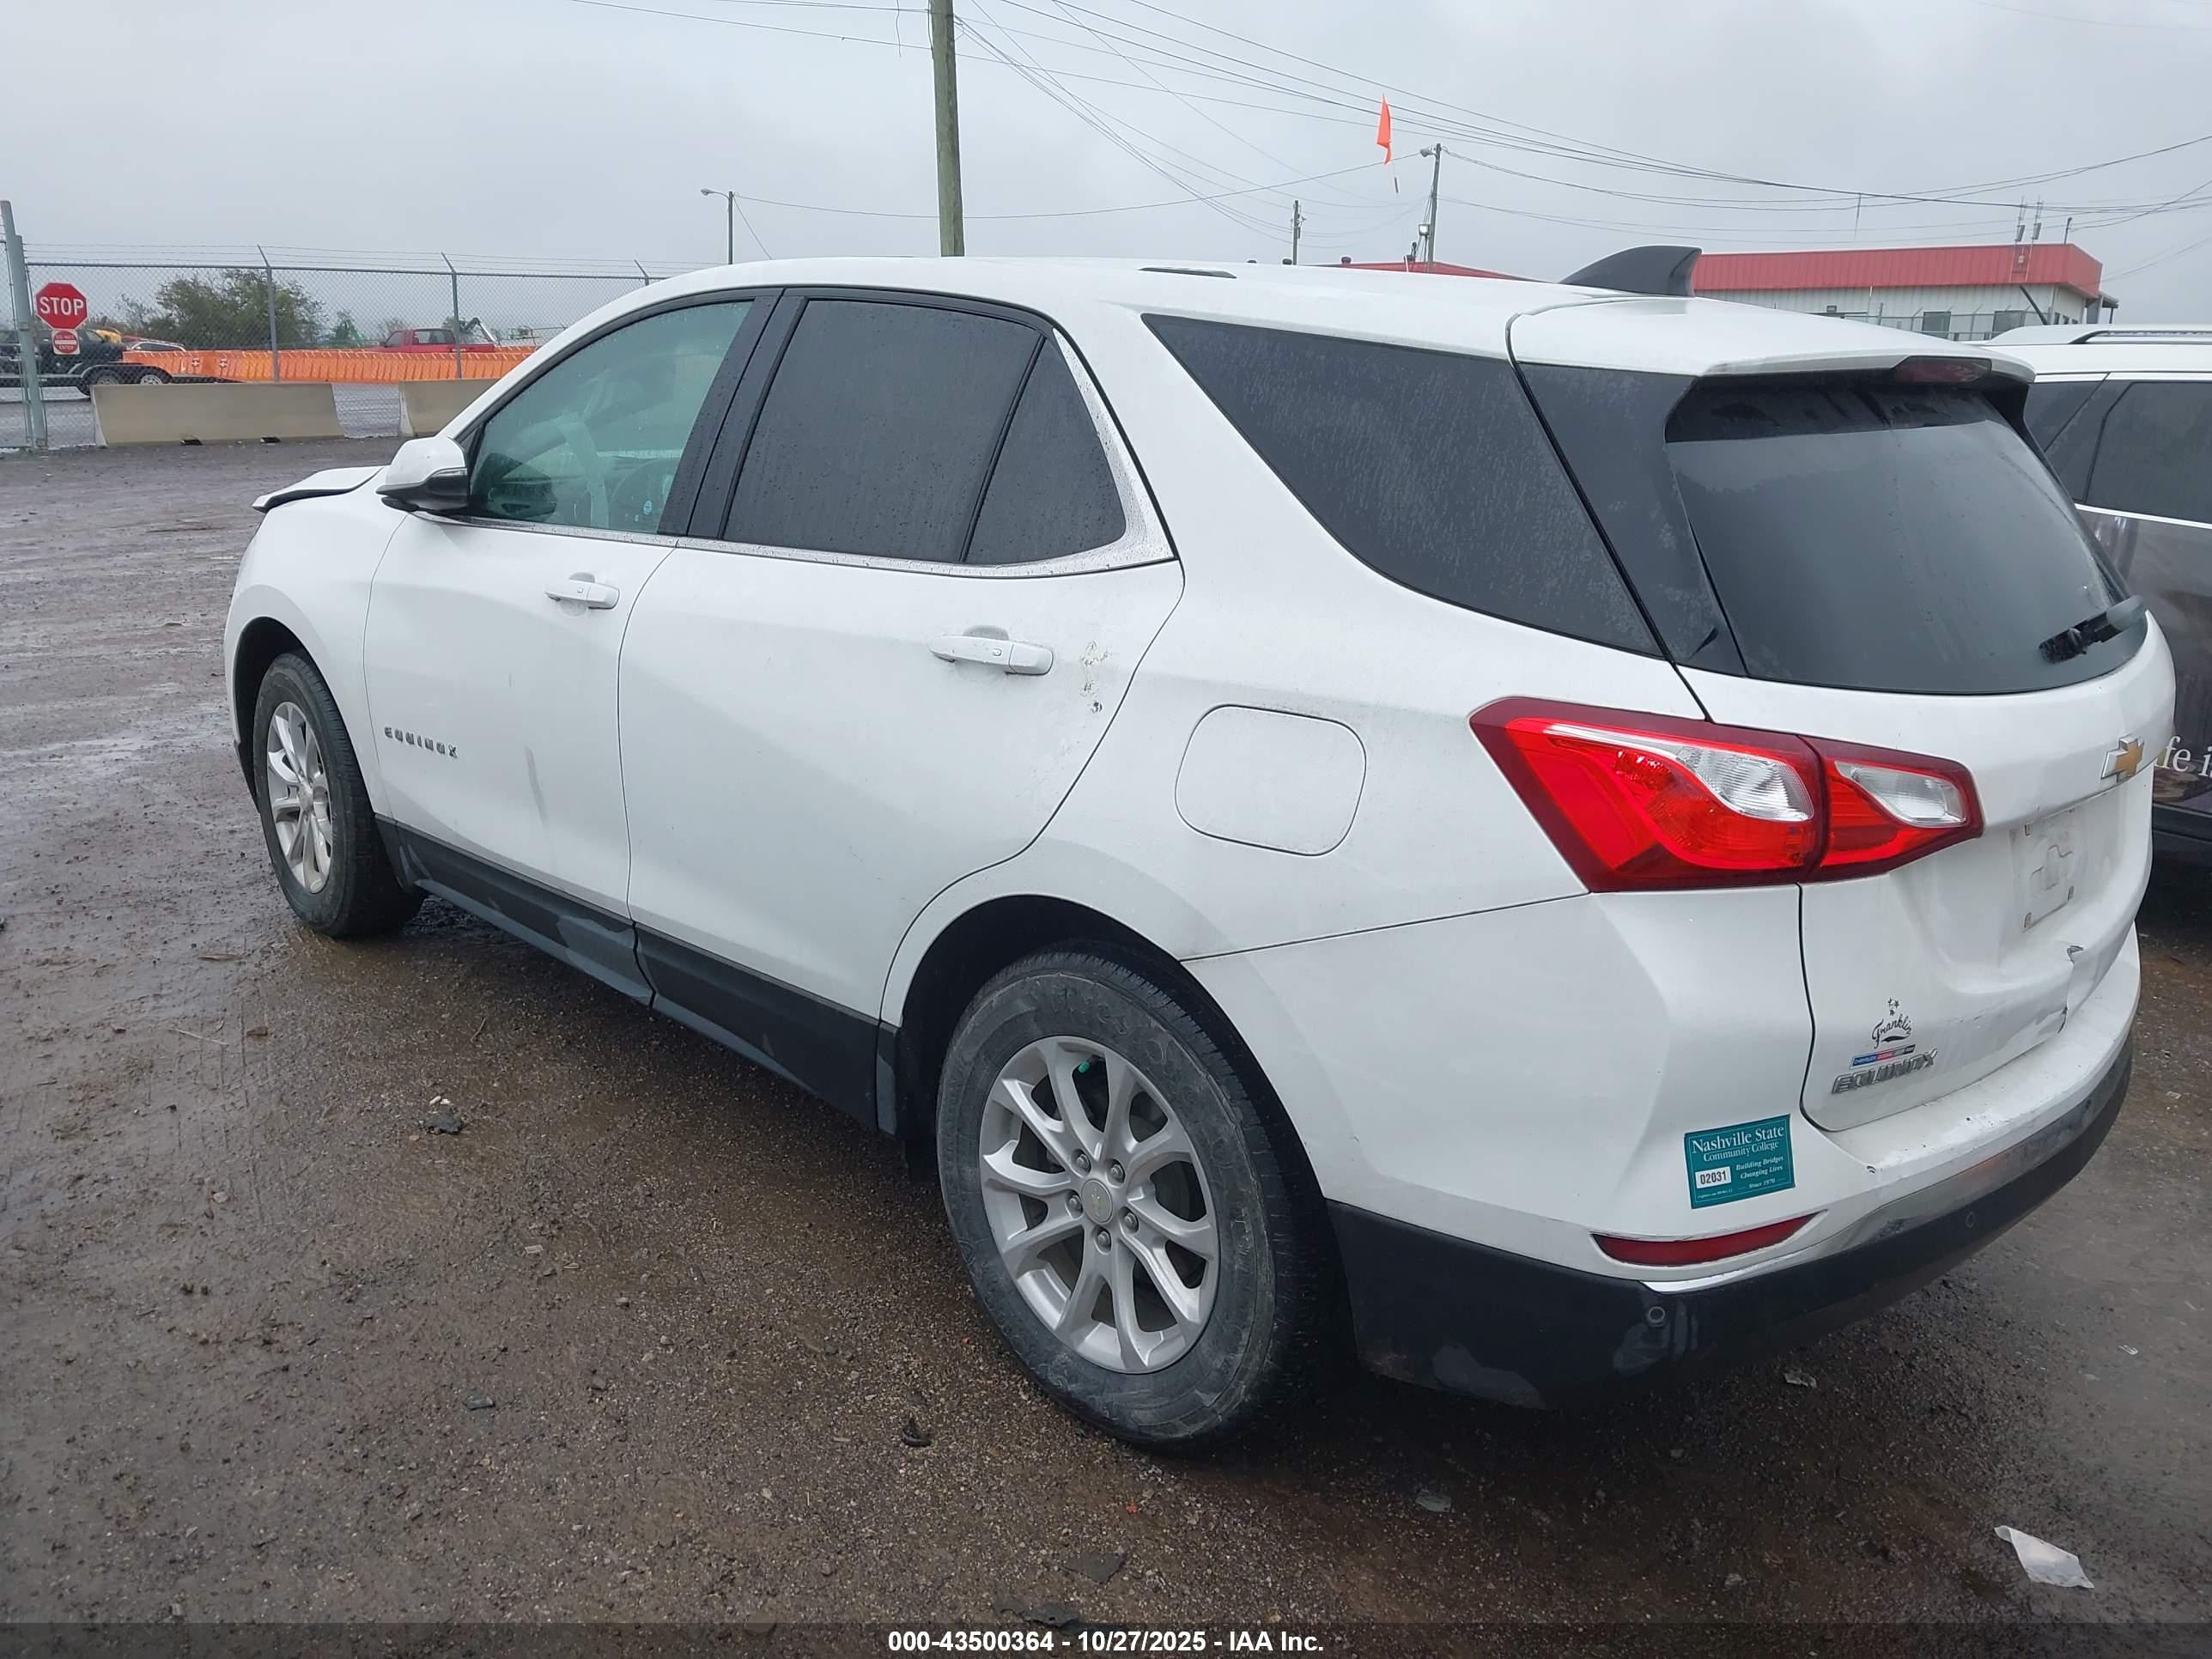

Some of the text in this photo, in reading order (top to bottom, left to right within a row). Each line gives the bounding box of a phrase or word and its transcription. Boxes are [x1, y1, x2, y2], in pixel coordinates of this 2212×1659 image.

[40, 296, 84, 316] STOP
[384, 726, 459, 759] EQUINOX
[1871, 1012, 1913, 1049] Franklin
[1831, 1048, 1939, 1094] EQUINOX
[1692, 1126, 1785, 1154] Nashville State
[1703, 1140, 1780, 1163] Community College
[1735, 1155, 1784, 1171] Building Bridges
[1740, 1165, 1784, 1179] Changing Lives
[1699, 1170, 1728, 1185] 02031
